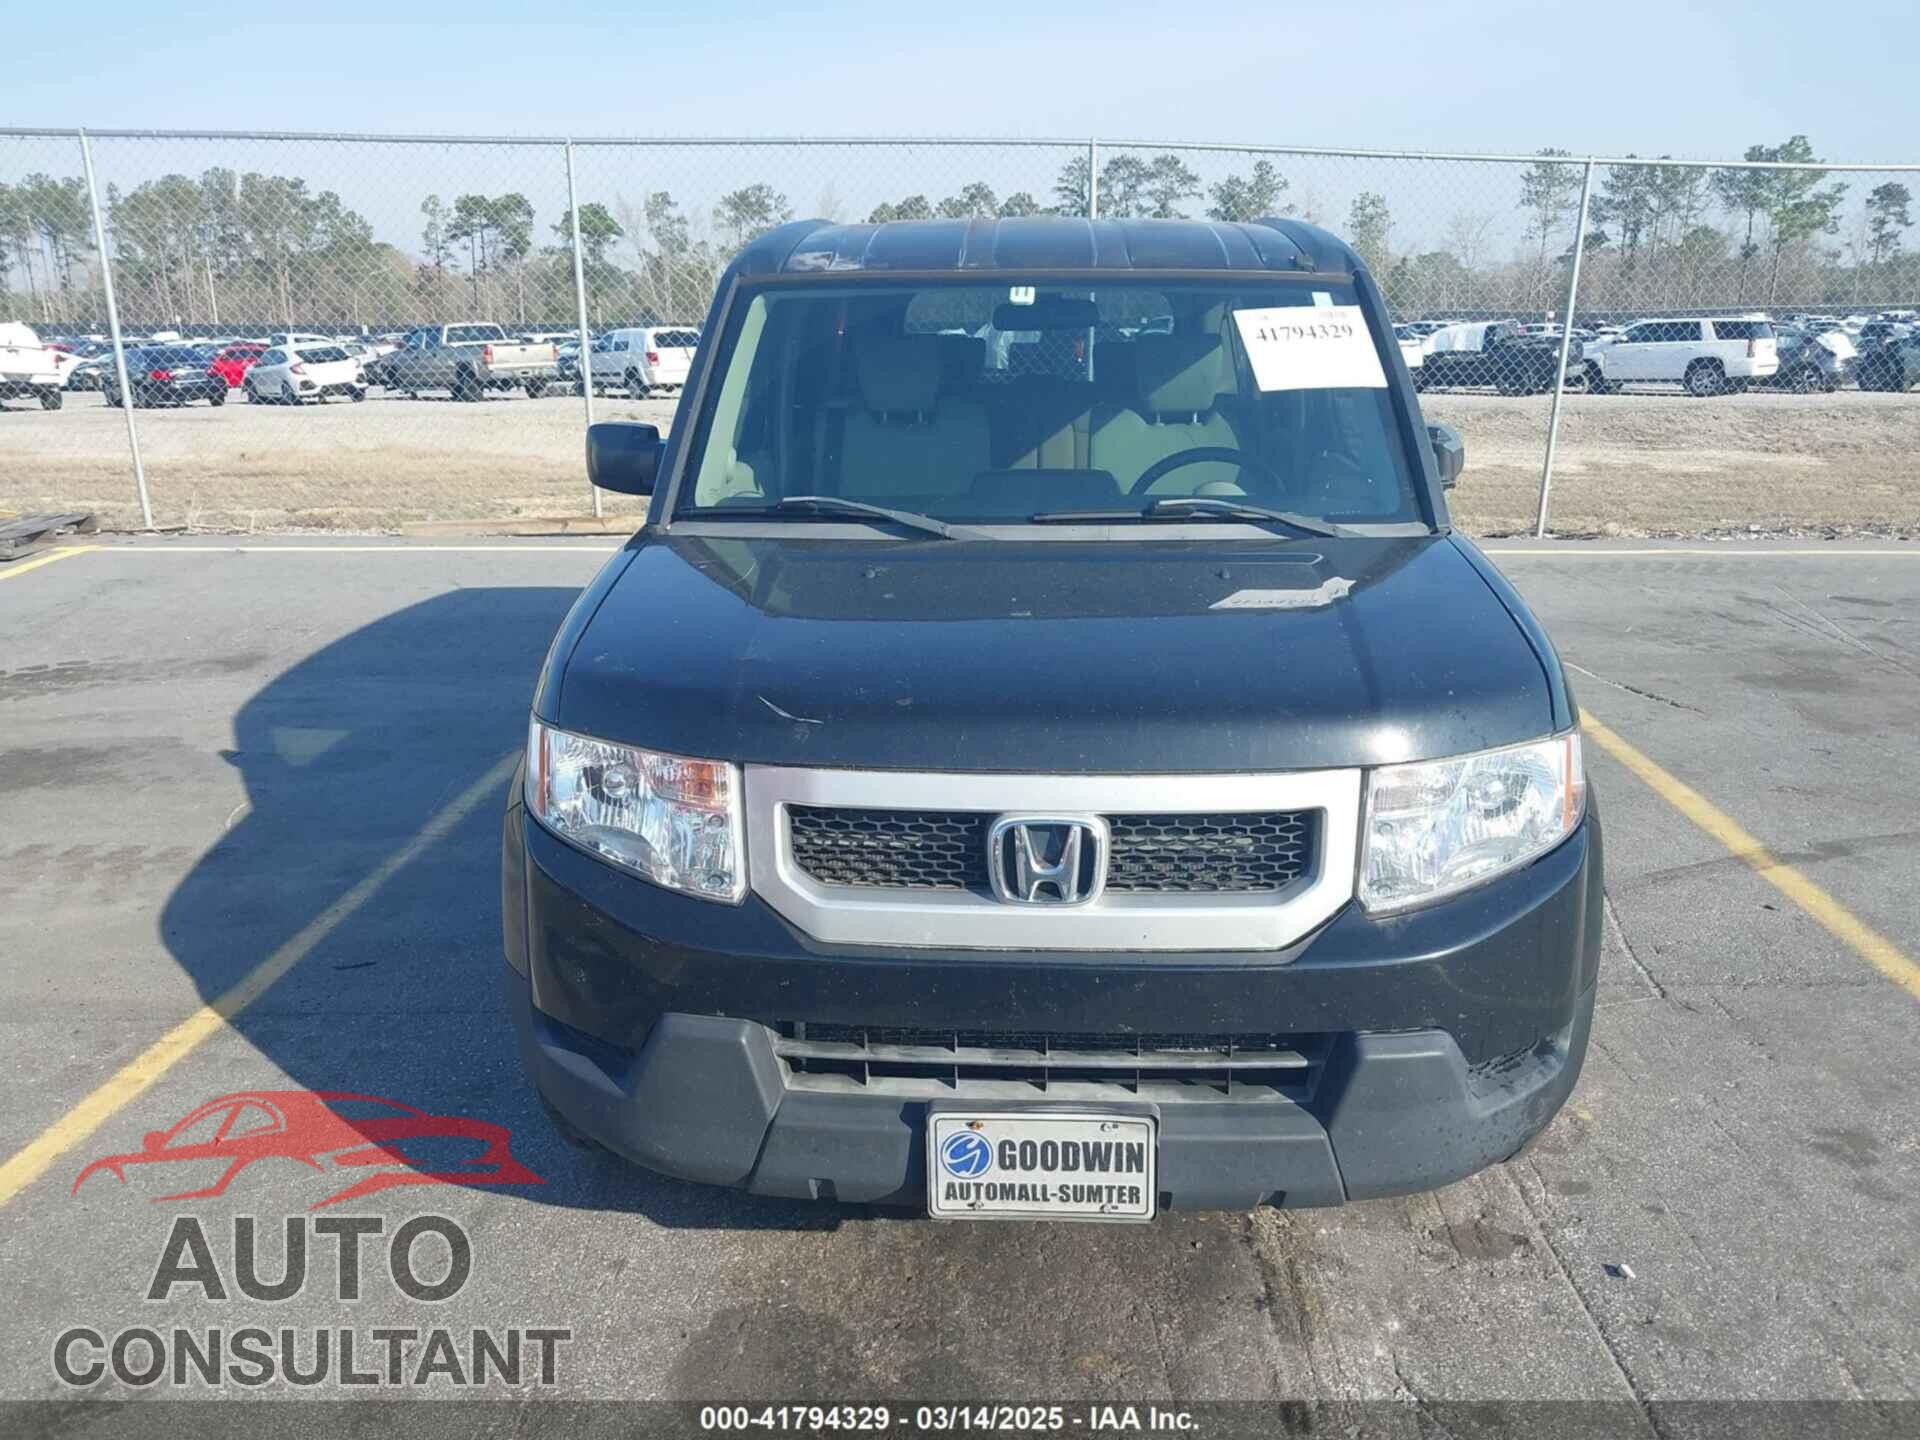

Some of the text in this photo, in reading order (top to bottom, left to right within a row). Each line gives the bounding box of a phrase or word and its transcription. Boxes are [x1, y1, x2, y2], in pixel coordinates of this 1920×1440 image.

[1256, 323, 1353, 342] 41794329
[997, 1139, 1145, 1173] GOODWIN
[944, 1181, 1141, 1205] AUTOMALL-SUMTER
